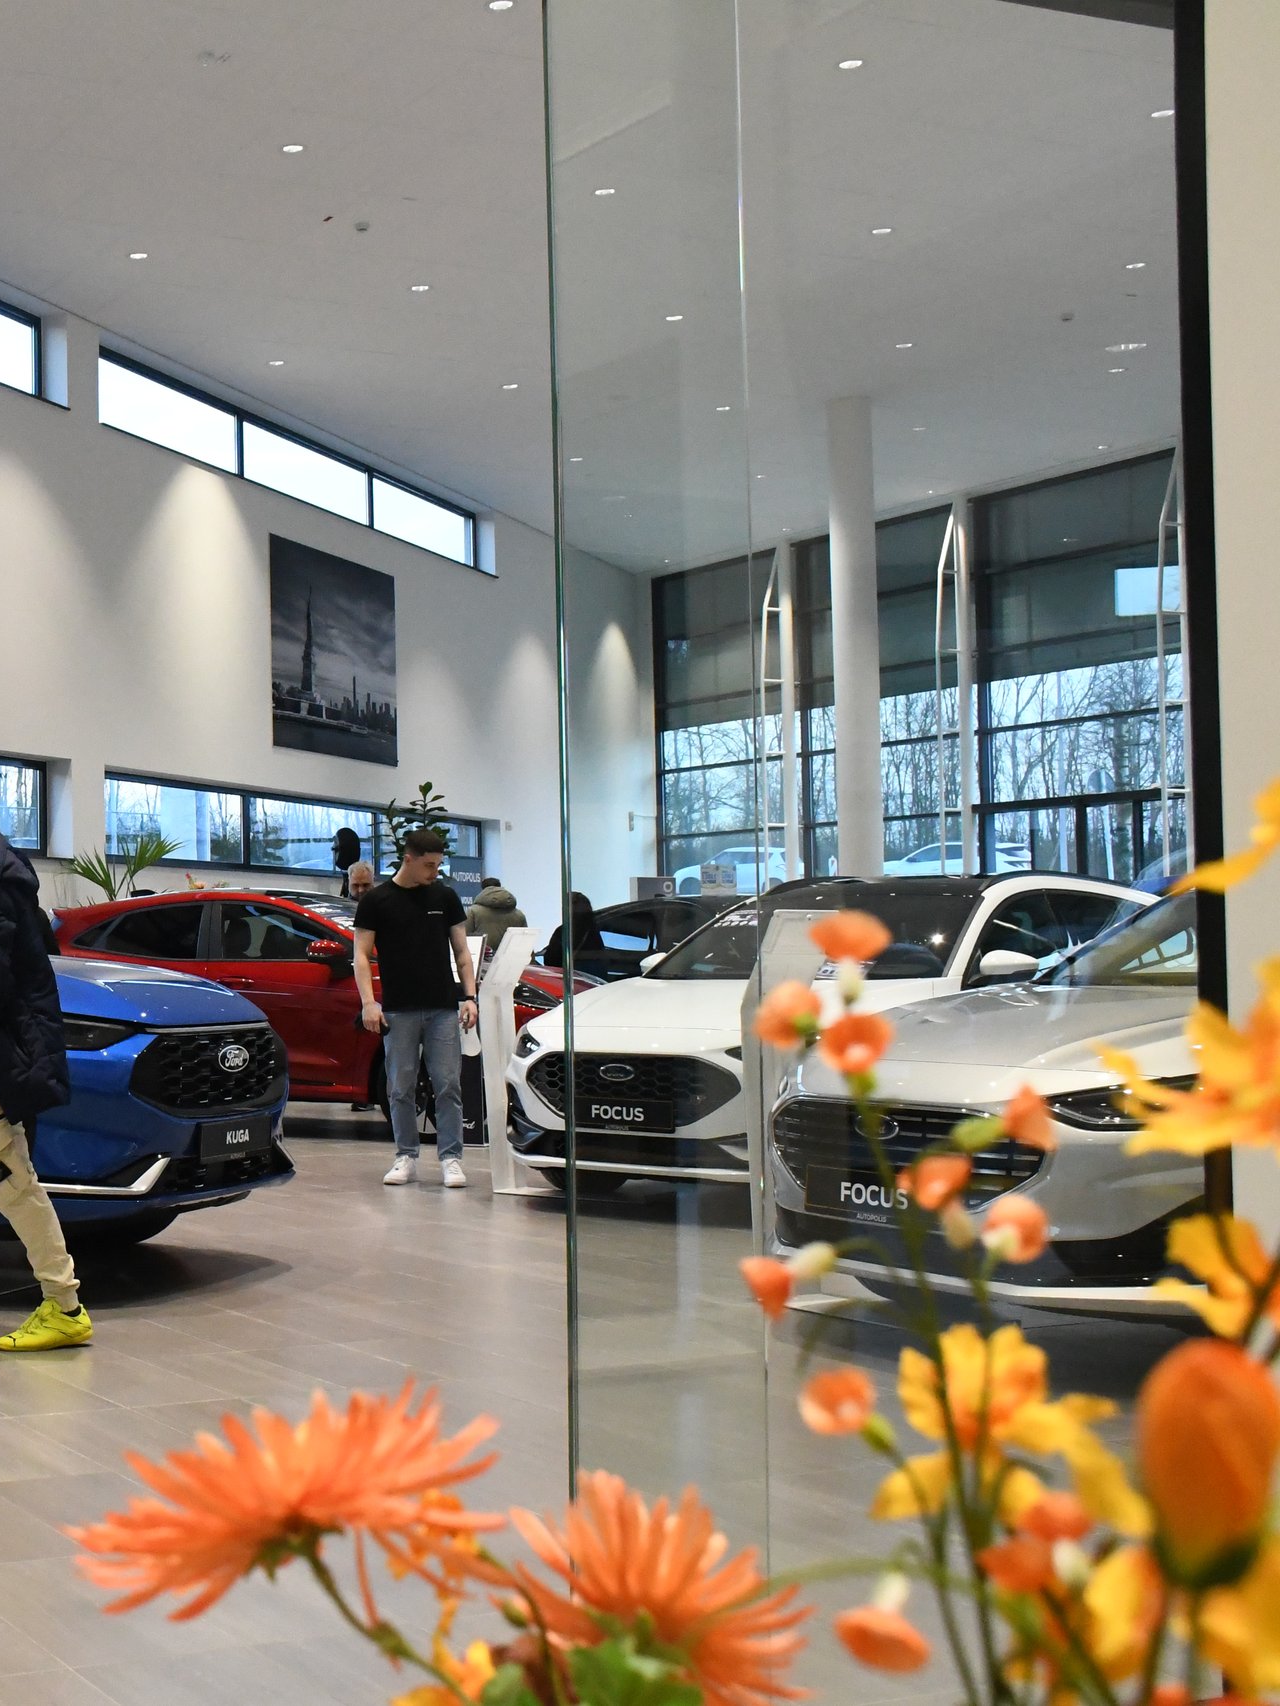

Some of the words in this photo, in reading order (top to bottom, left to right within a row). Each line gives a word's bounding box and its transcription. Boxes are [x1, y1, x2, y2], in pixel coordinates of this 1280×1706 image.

[452, 871, 481, 883] AUTOPOLIS
[225, 1049, 244, 1067] Ford
[591, 1105, 645, 1122] FOCUS
[226, 1129, 250, 1144] KUGA
[840, 1182, 909, 1210] FOCUS
[856, 1213, 887, 1223] AUTOPOLIS
